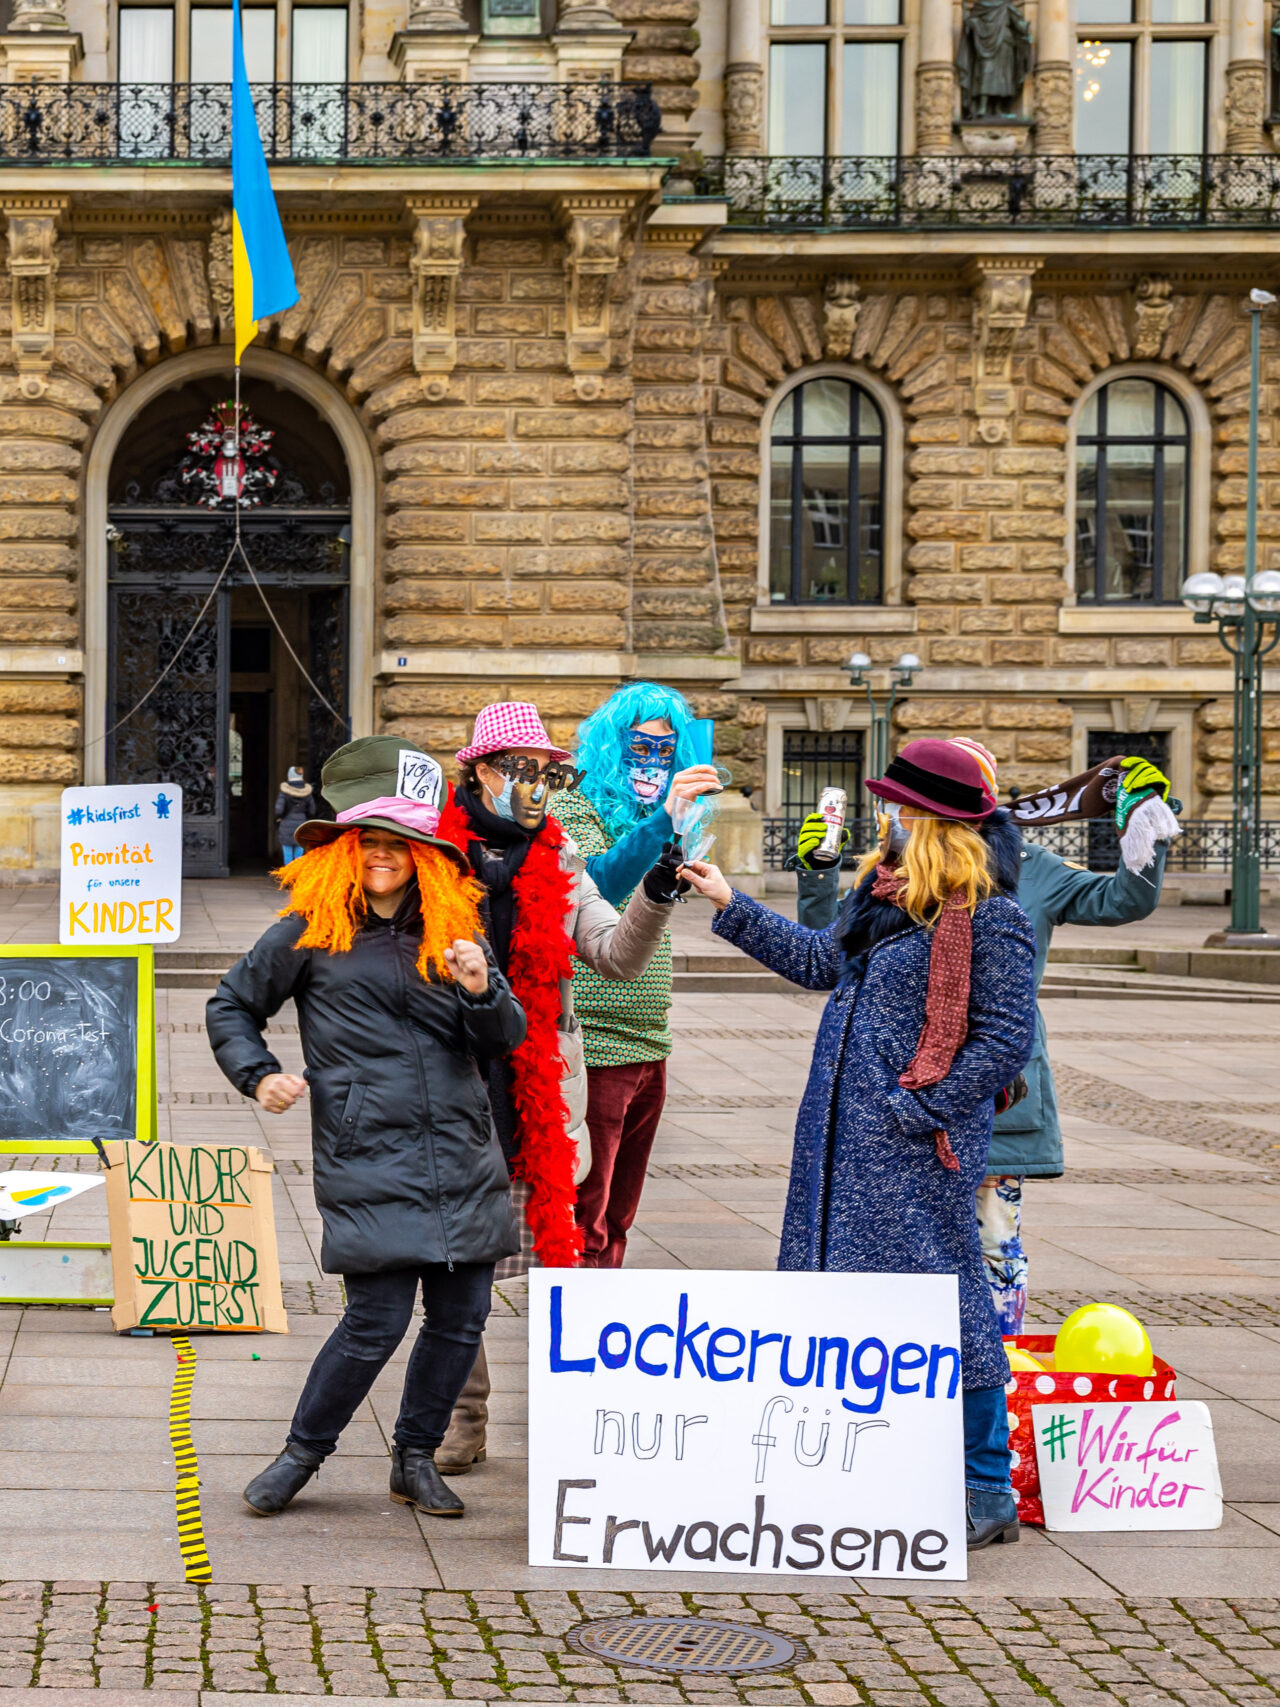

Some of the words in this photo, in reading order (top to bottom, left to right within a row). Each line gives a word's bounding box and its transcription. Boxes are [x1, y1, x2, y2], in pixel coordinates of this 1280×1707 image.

[66, 803, 141, 826] #kidsfirst
[70, 842, 154, 867] Priorität
[86, 879, 103, 892] für
[108, 878, 141, 888] unsere
[69, 898, 175, 936] KINDER
[125, 1141, 252, 1204] KINDER
[169, 1203, 224, 1236] UND
[133, 1236, 258, 1283] JUGEND
[139, 1281, 260, 1327] ZUERST
[550, 1286, 961, 1413] Lockerungen
[594, 1409, 709, 1461] nur
[751, 1395, 891, 1484] für
[1071, 1467, 1206, 1514] Kinder
[553, 1478, 949, 1573] Erwachsene
